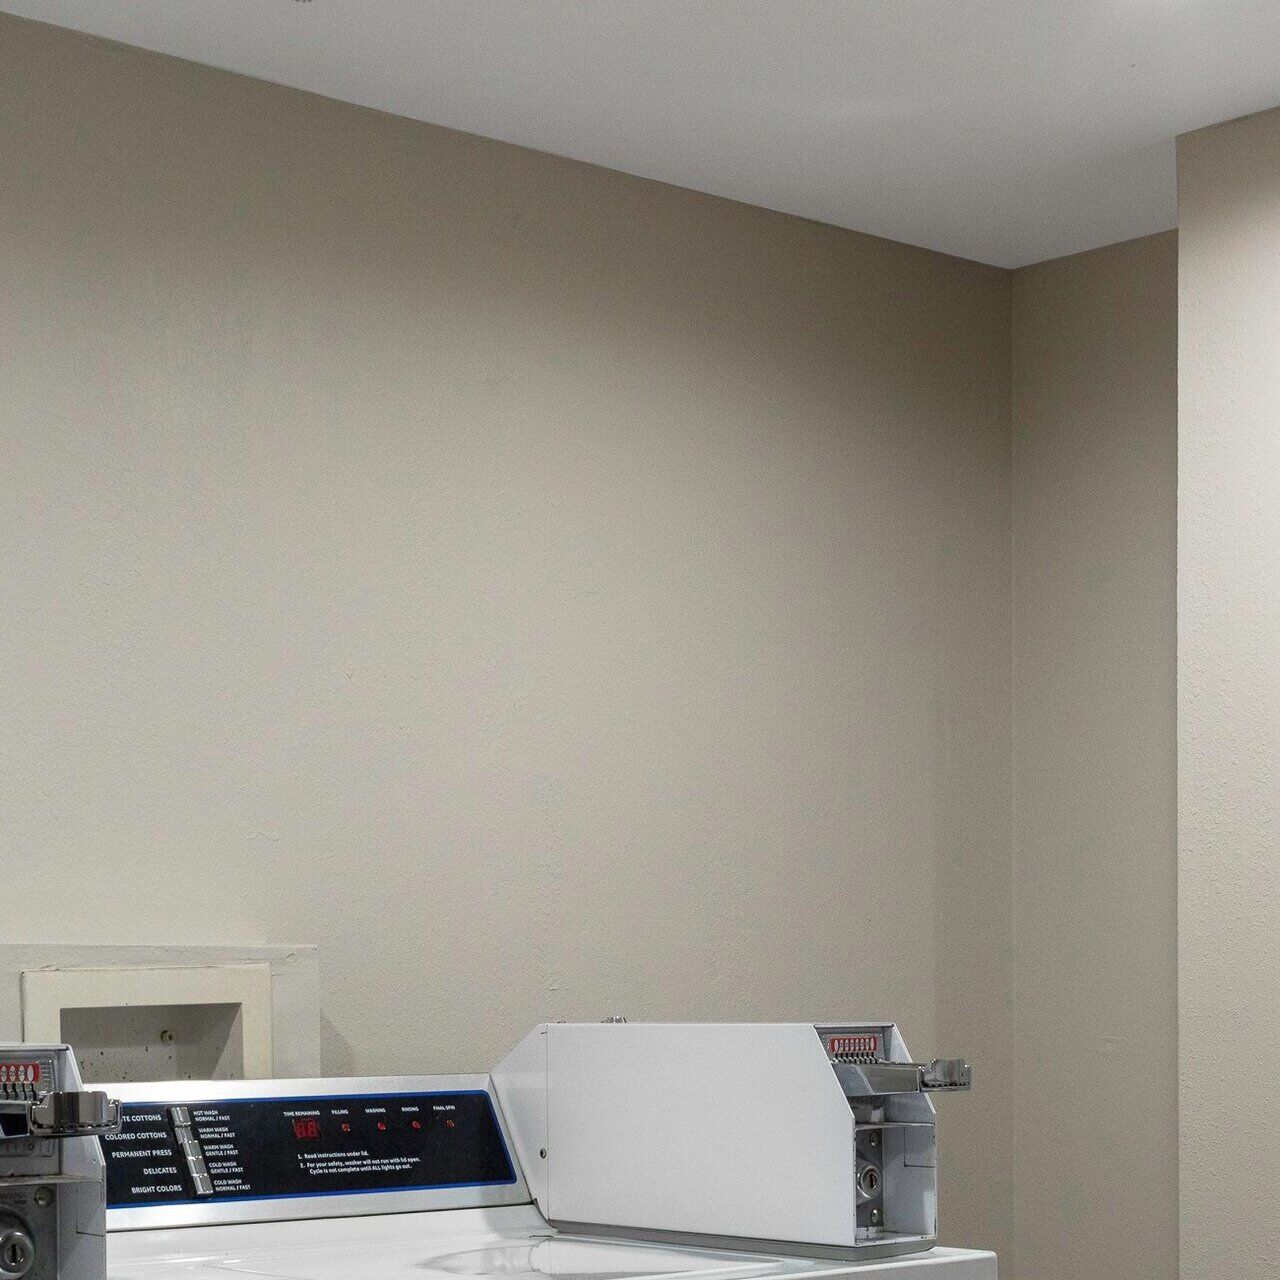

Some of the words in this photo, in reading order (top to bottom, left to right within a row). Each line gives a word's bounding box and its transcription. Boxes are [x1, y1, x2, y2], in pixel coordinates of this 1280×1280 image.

[104, 1133, 136, 1141] COLORED
[136, 1132, 168, 1140] COTTONS
[111, 1150, 152, 1158] PERMANENT
[143, 1166, 178, 1175] DELICATES
[131, 1186, 156, 1194] BRIGHT
[157, 1184, 182, 1192] COLORS
